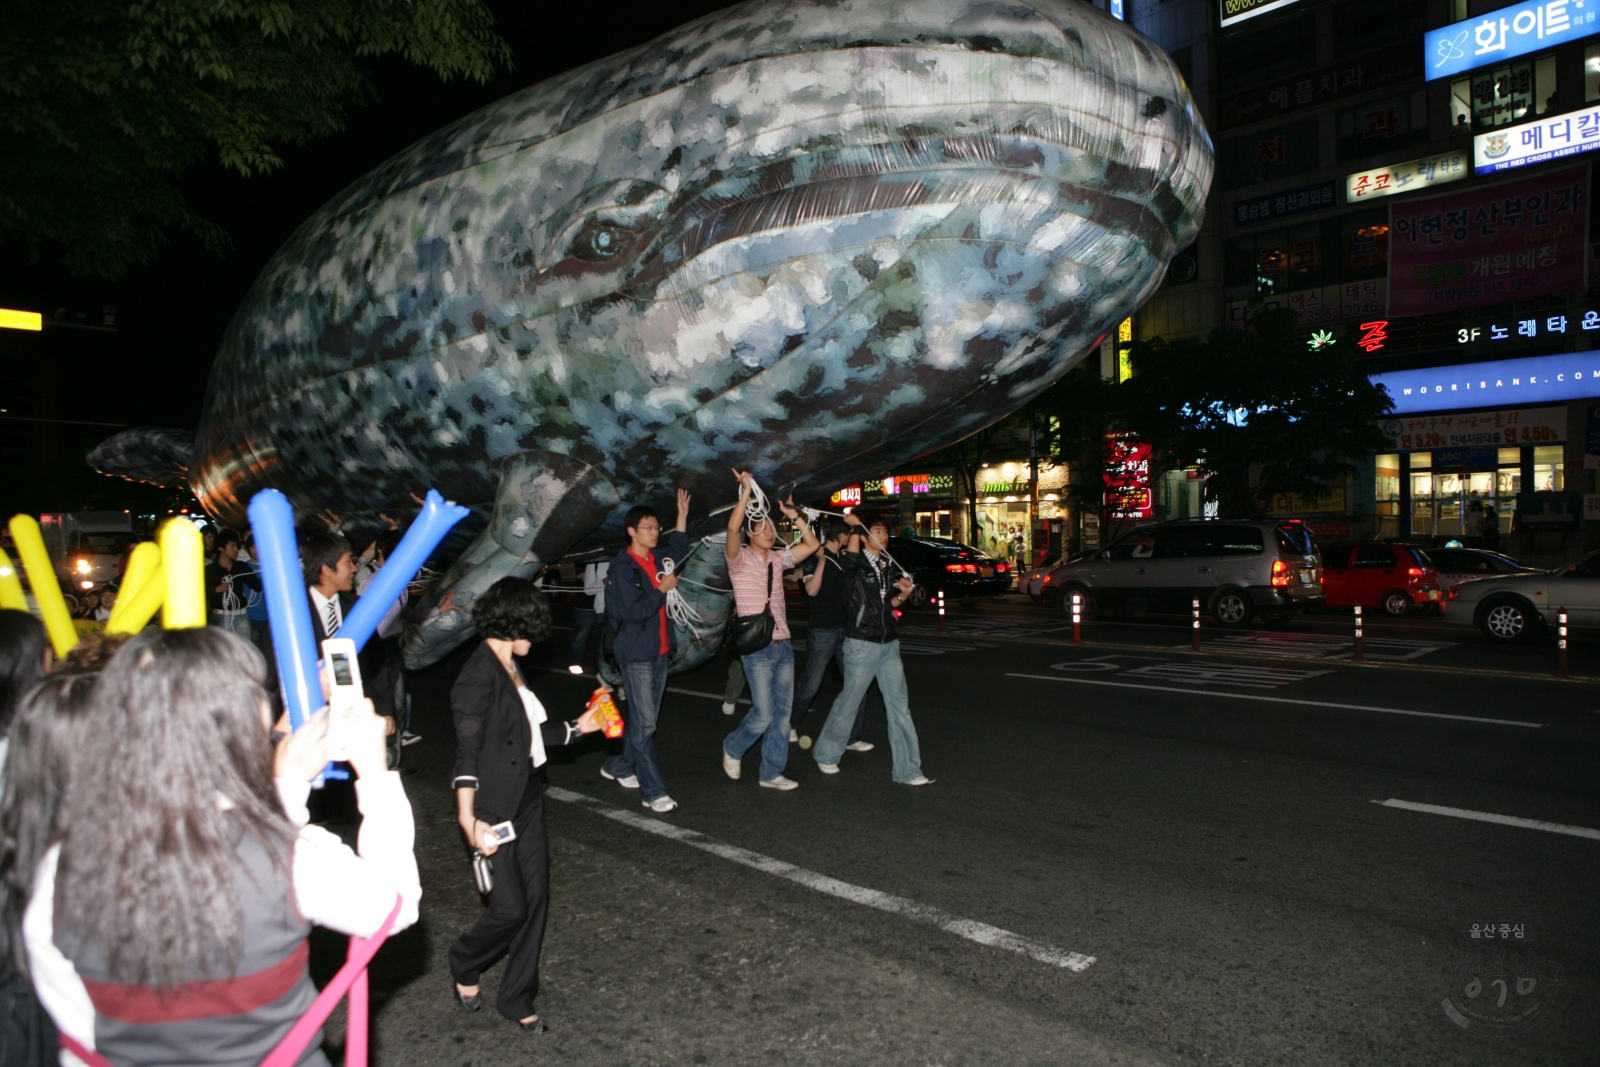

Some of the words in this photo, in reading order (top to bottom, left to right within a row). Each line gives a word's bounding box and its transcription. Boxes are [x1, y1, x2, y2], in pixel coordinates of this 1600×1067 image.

[1474, 0, 1571, 56] 화이트
[1573, 11, 1596, 26] 의원
[1268, 64, 1365, 110] 애플치과
[1495, 162, 1509, 170] THE
[1510, 159, 1525, 167] RED
[1527, 152, 1552, 163] CROSS
[1554, 146, 1580, 158] ASSIST
[1237, 200, 1270, 222] 홍승범
[1275, 185, 1333, 214] 정신과의원
[1396, 207, 1469, 245] 이현정
[1473, 181, 1584, 236] 산부인과
[1457, 326, 1482, 344] 3F
[1401, 434, 1413, 448] 연
[1504, 427, 1517, 443] 연
